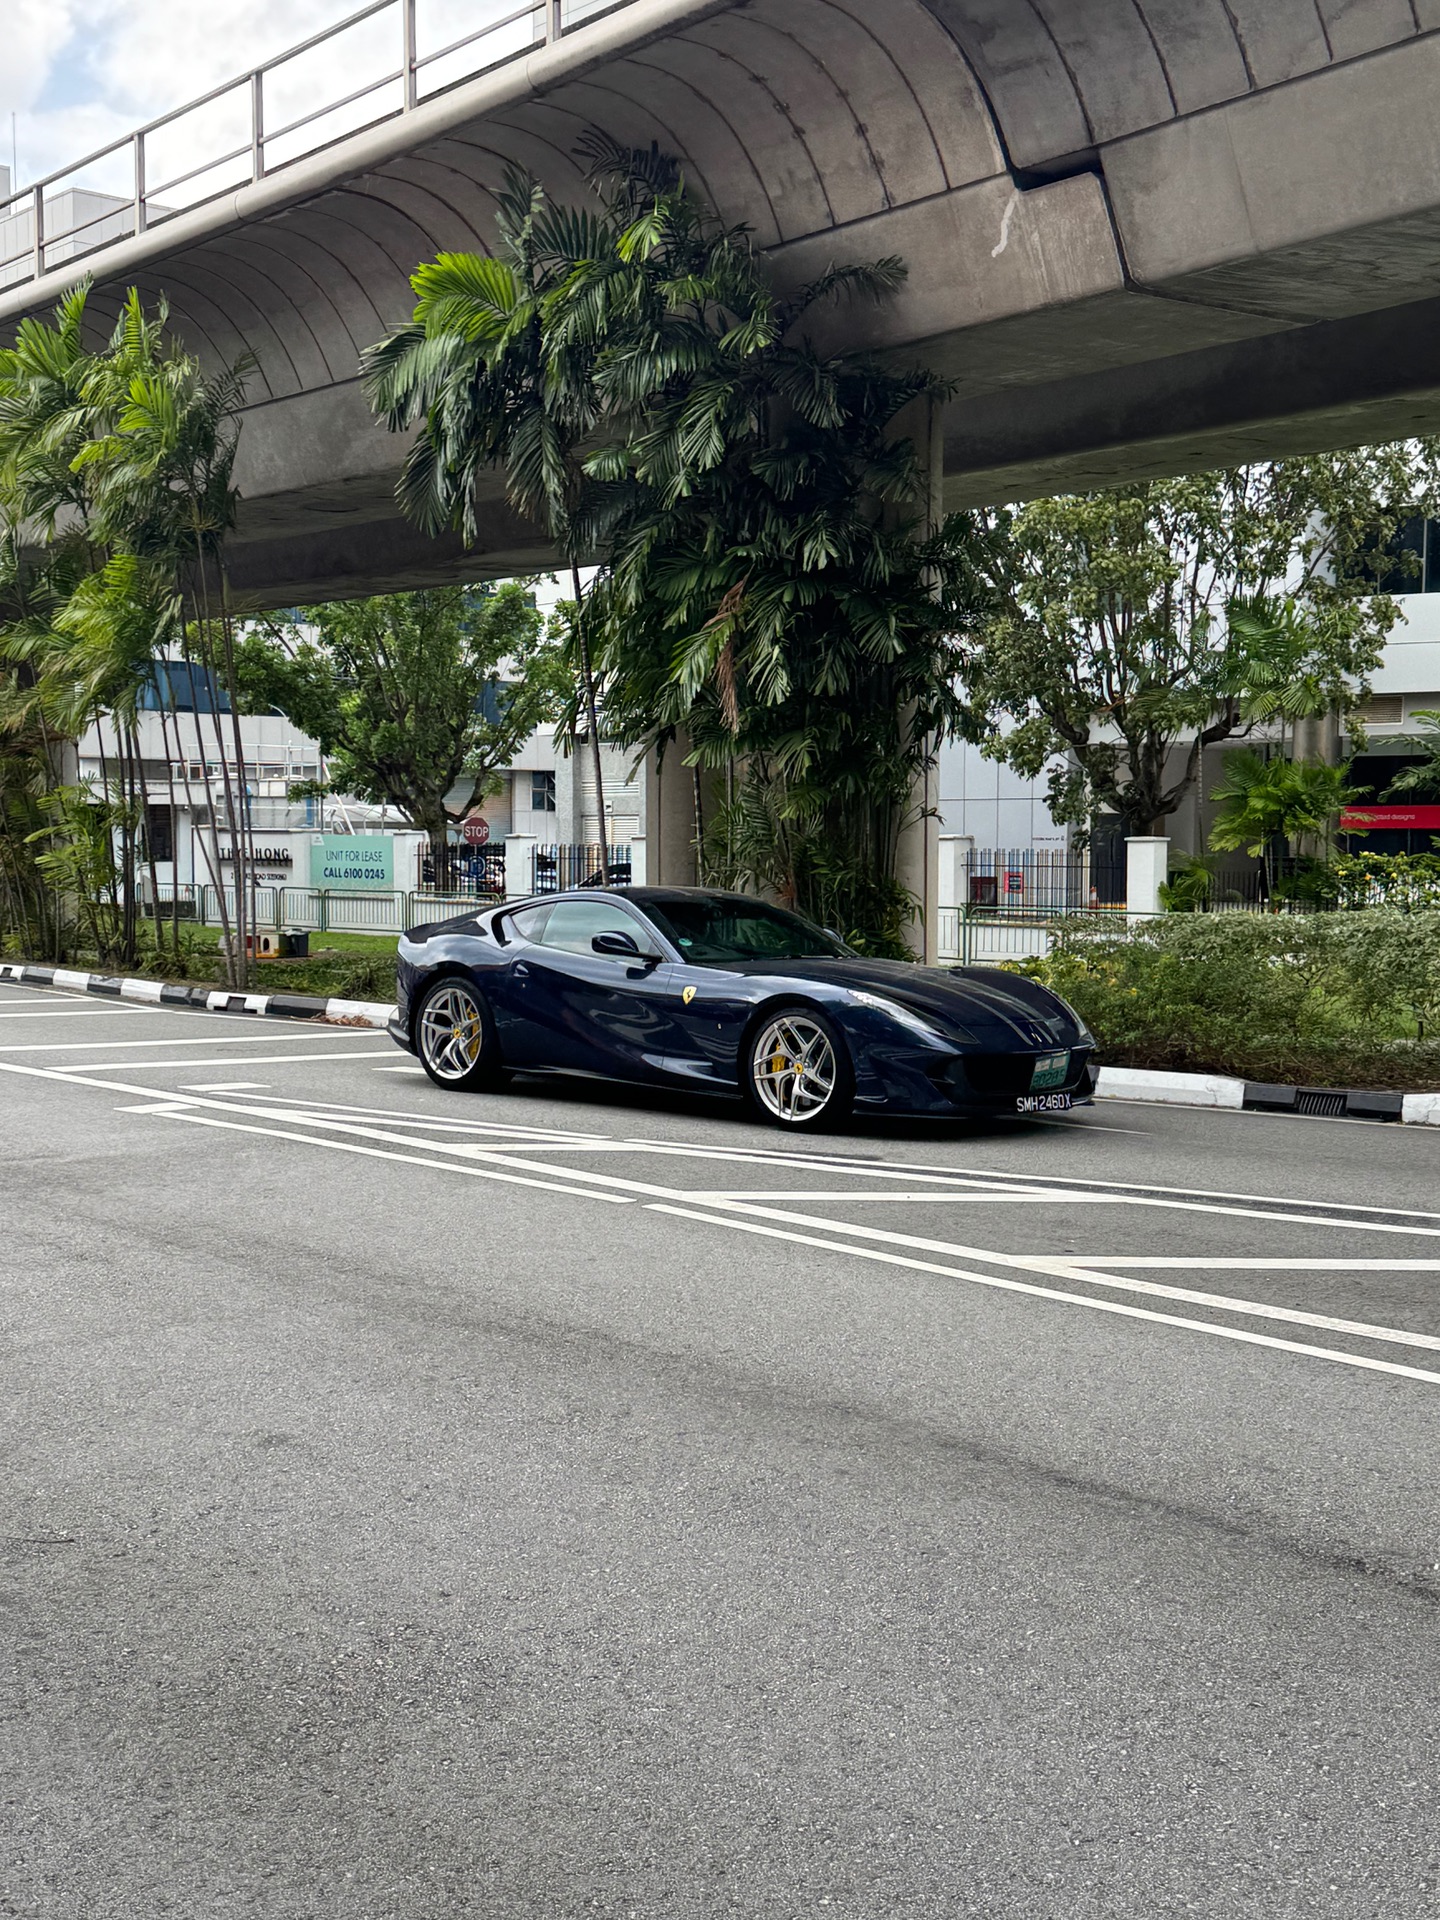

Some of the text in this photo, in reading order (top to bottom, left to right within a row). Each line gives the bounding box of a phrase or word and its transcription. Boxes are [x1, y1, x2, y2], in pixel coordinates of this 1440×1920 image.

[464, 825, 489, 838] STOP
[255, 848, 289, 860] HONG
[325, 850, 383, 862] UNIT FOR LEASE
[323, 867, 385, 880] CALL 6100 0245
[1016, 1093, 1072, 1113] SMH2460X
